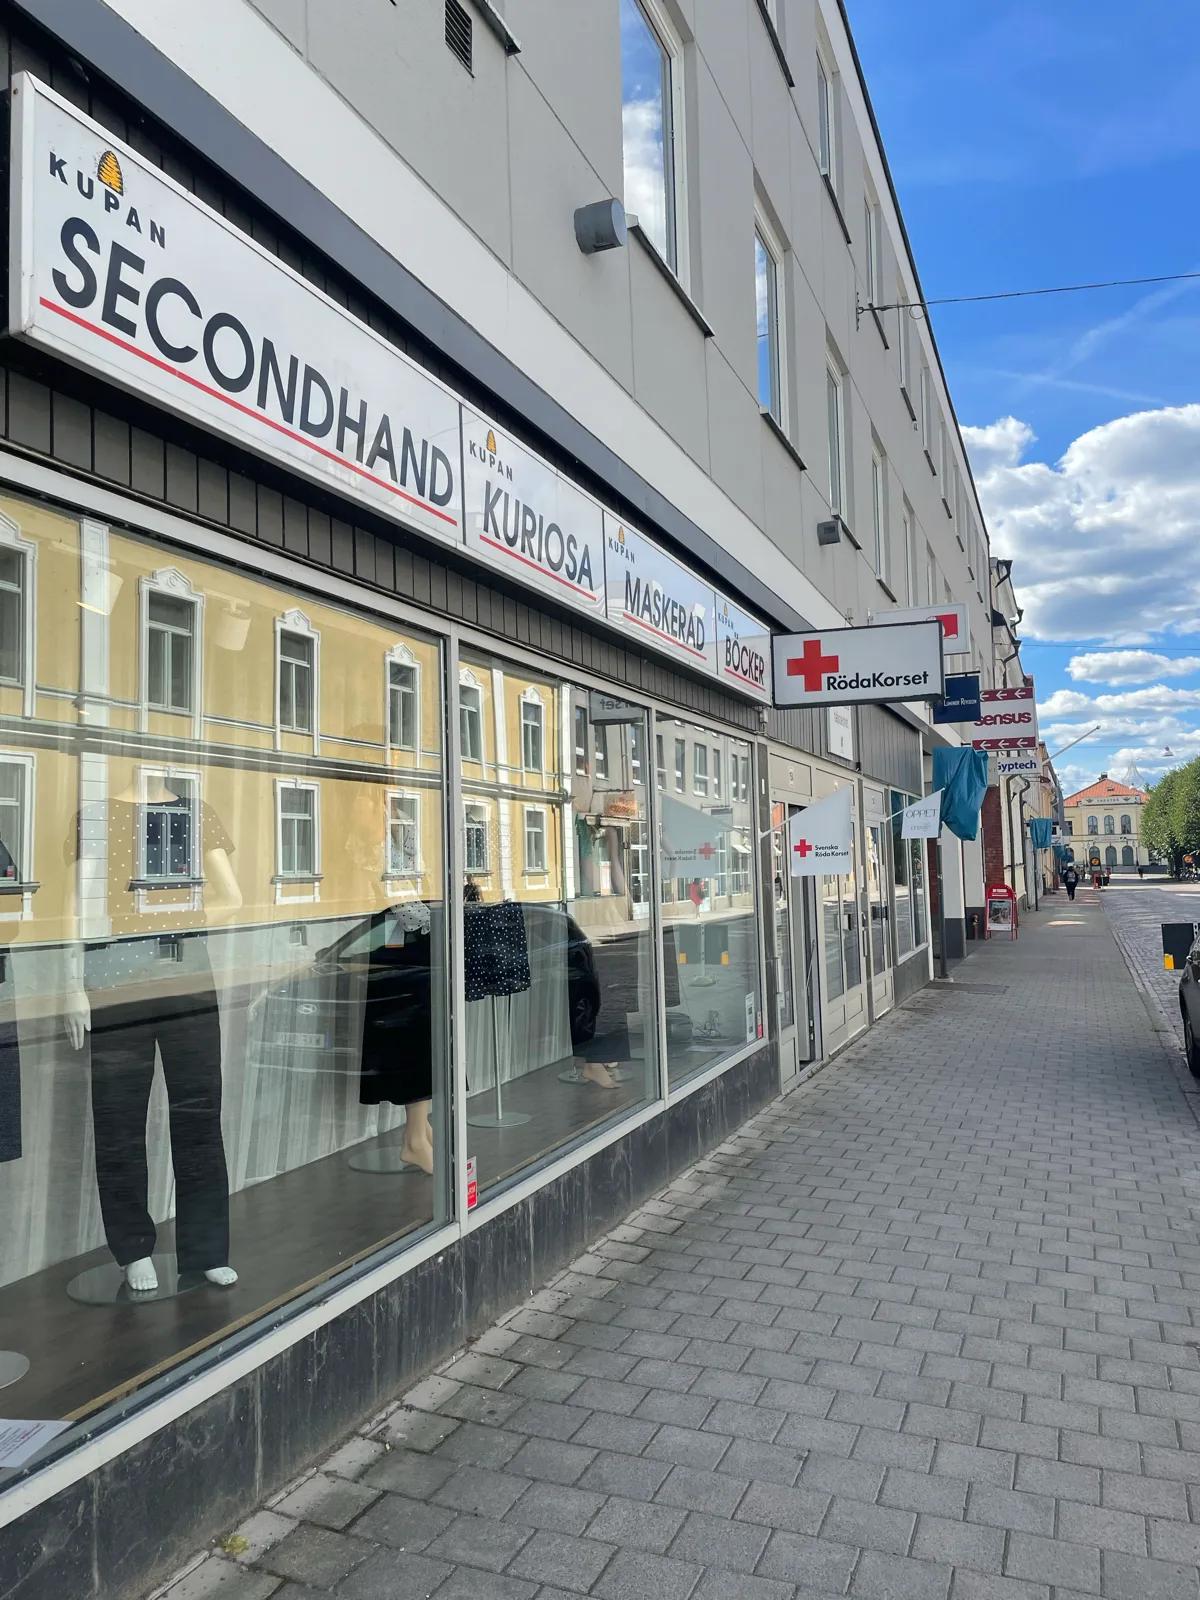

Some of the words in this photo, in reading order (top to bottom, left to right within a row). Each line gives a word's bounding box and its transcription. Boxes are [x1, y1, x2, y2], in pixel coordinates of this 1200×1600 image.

[49, 151, 166, 249] KUPAN
[51, 216, 455, 507] SECONDHAND
[469, 440, 513, 481] KUPAN
[483, 480, 594, 591] KURIOSA
[608, 537, 635, 563] KUPAN
[624, 570, 705, 651] MASKERAD
[725, 632, 766, 686] BÖCKER
[826, 671, 929, 691] RödaKorset
[974, 711, 1032, 726] sensus
[815, 850, 831, 858] Röda
